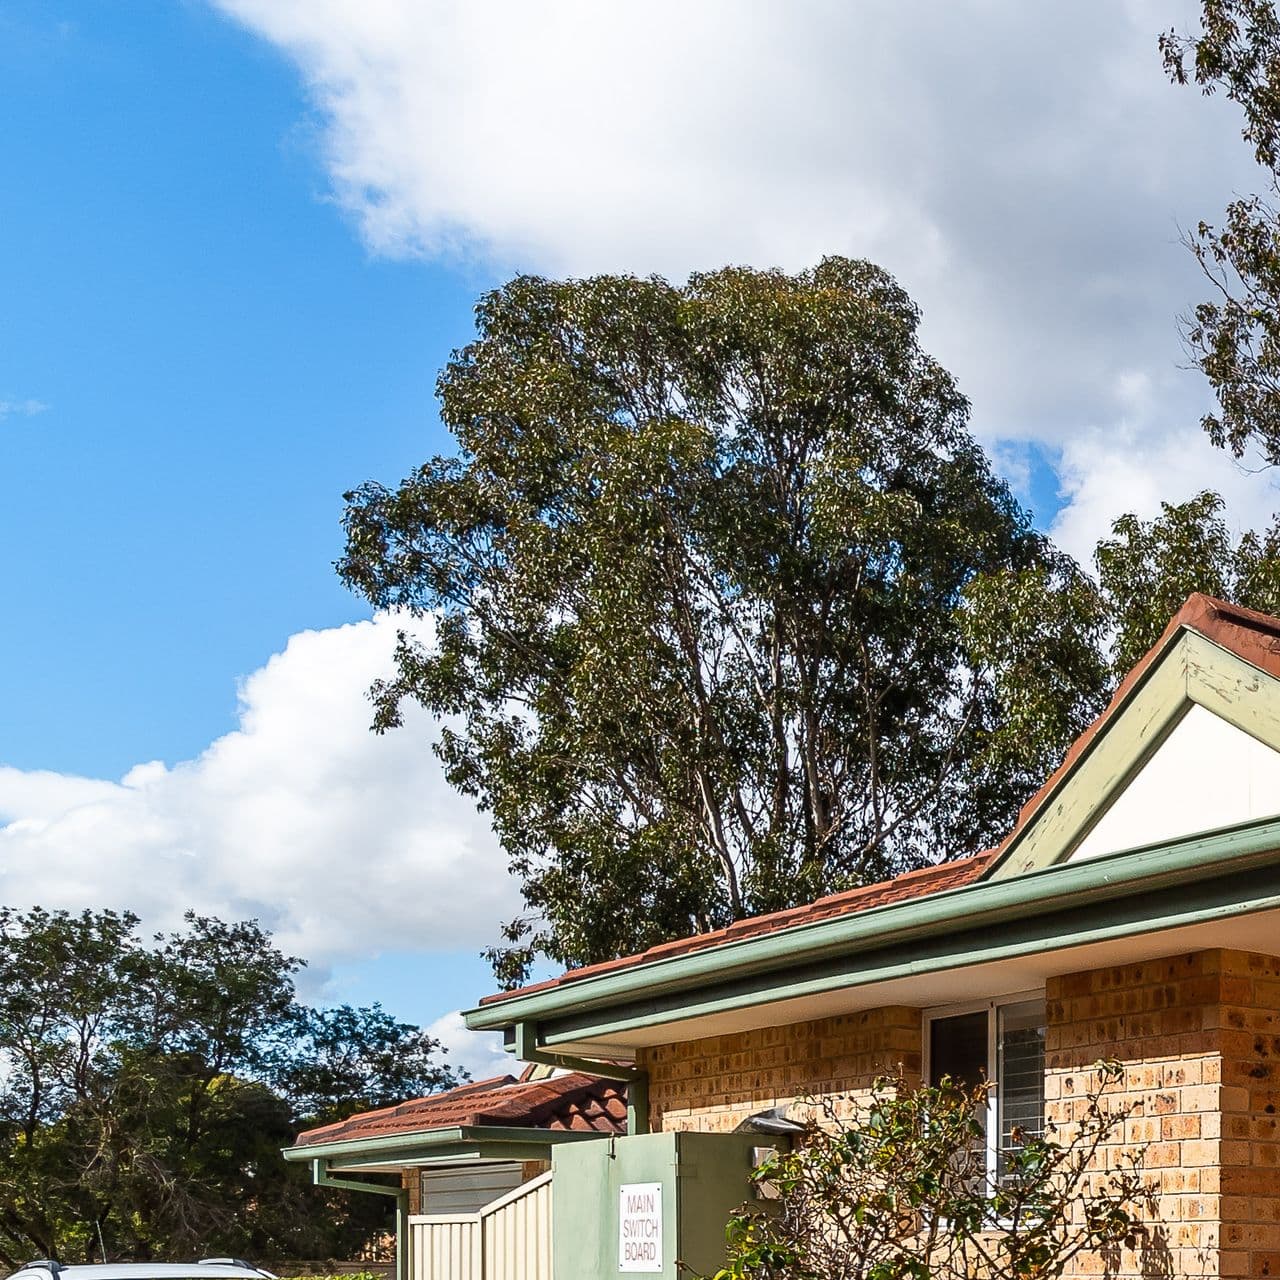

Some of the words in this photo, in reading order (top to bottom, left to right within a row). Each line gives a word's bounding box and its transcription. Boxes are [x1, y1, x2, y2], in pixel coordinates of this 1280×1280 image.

[627, 1194, 654, 1214] MAIN
[623, 1219, 658, 1238] SWITCH
[625, 1242, 656, 1261] BOARD
